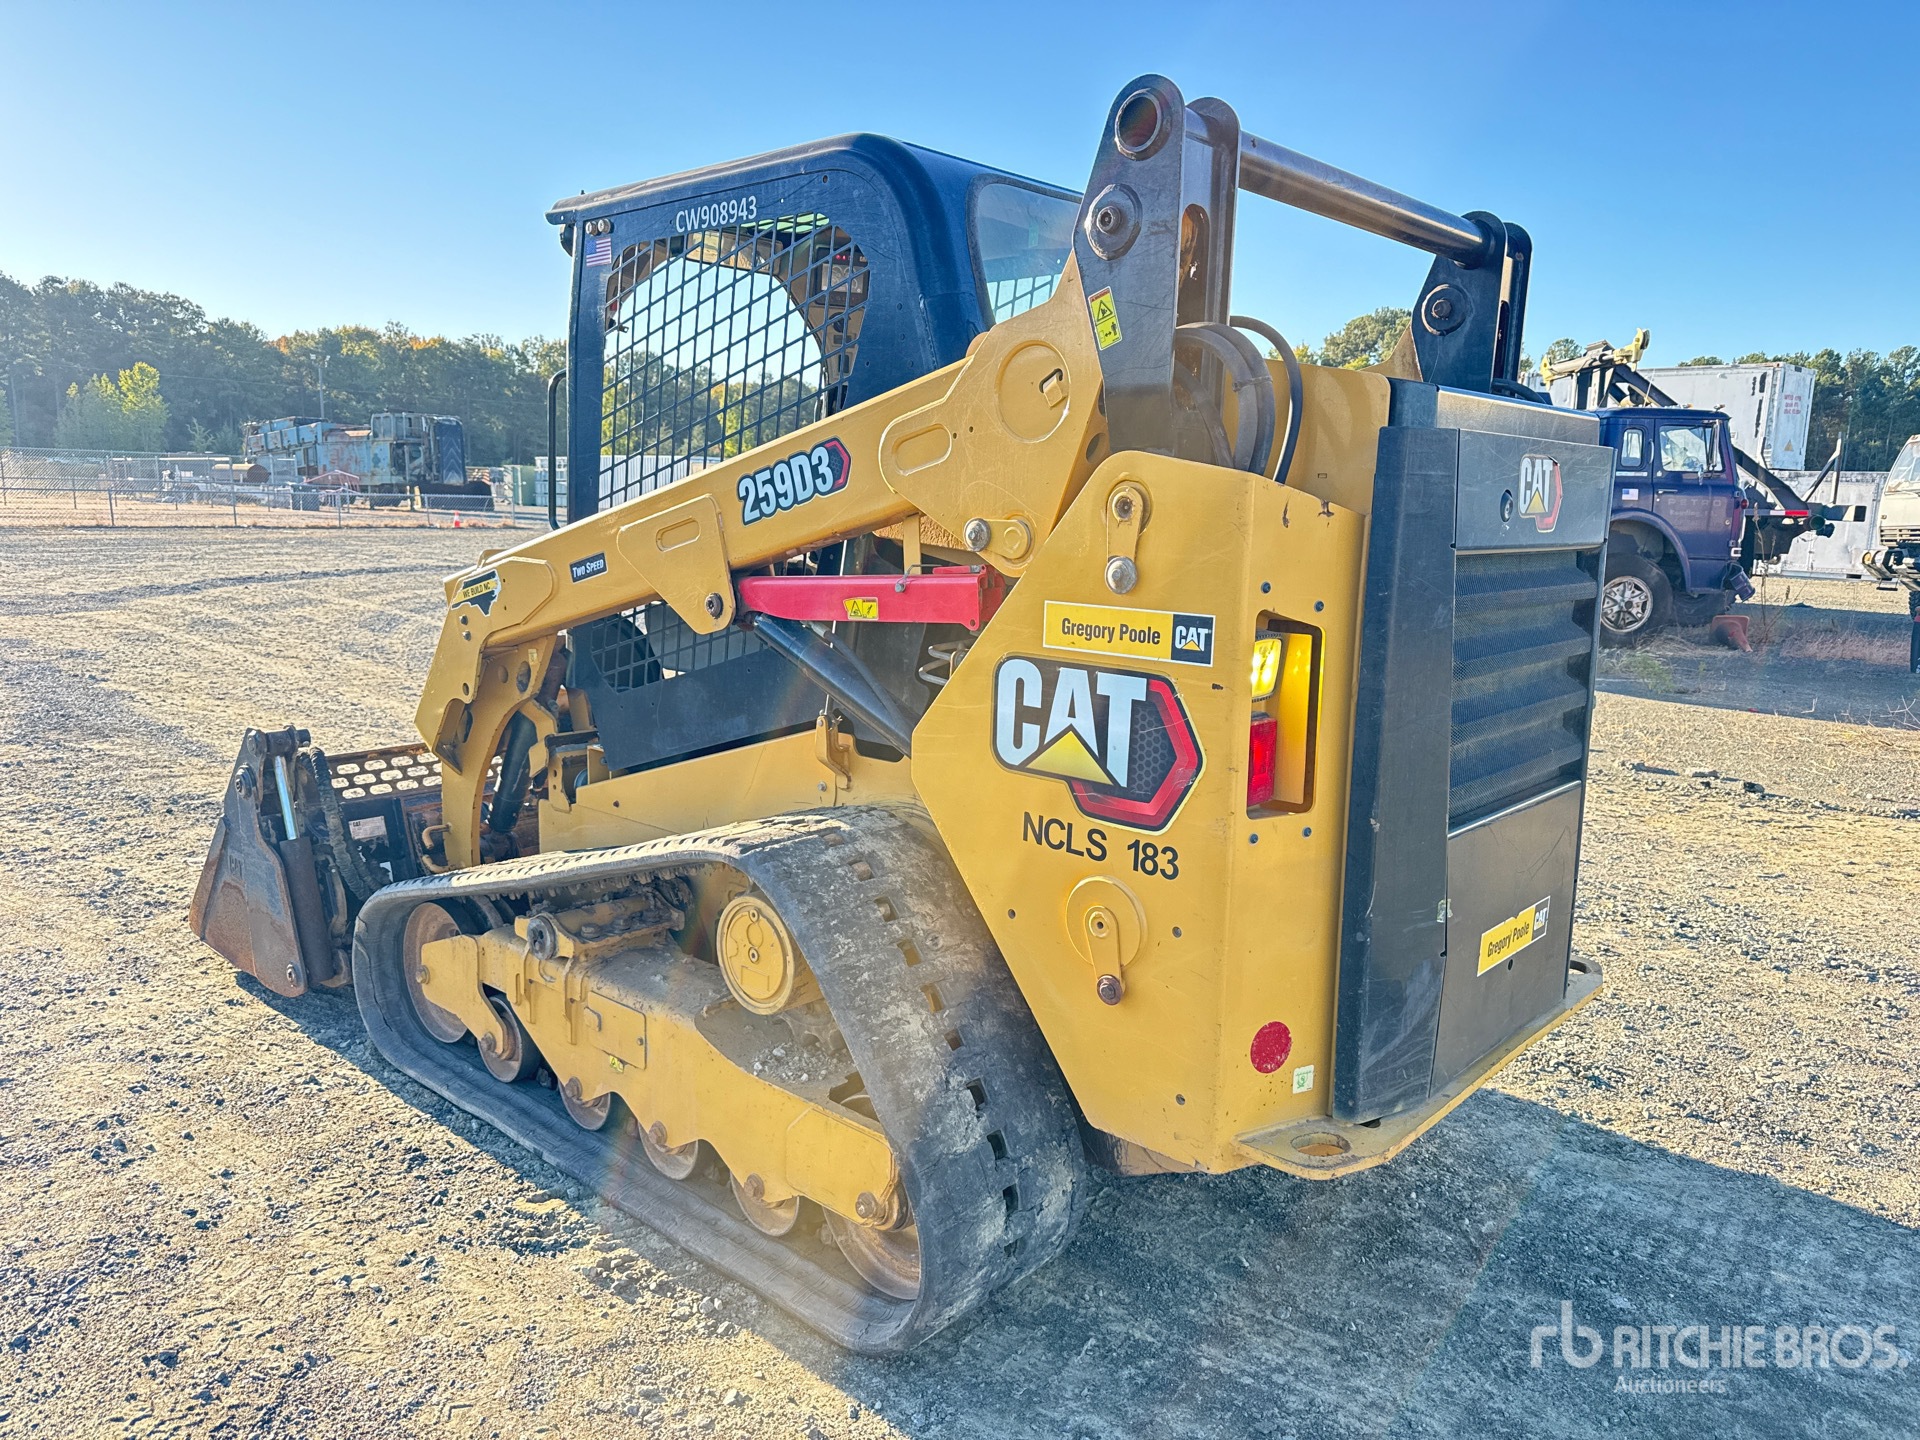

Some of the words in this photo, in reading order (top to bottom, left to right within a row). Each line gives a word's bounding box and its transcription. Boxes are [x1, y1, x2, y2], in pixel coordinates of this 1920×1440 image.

[675, 195, 757, 232] CW908943
[738, 446, 834, 522] 259D3
[1519, 457, 1553, 514] CAT
[1667, 499, 1722, 507] PETRO
[463, 589, 470, 598] WE
[470, 584, 483, 596] BUILD
[483, 582, 491, 590] NC
[1061, 617, 1115, 645] Gregory
[1119, 623, 1161, 645] Poole
[1174, 625, 1209, 652] CAT
[996, 659, 1147, 788] CAT
[1022, 811, 1107, 862] NCLS
[1126, 838, 1180, 881] 183
[1488, 934, 1511, 957] Gregory
[1512, 922, 1530, 941] Poole
[1534, 907, 1548, 930] CAT
